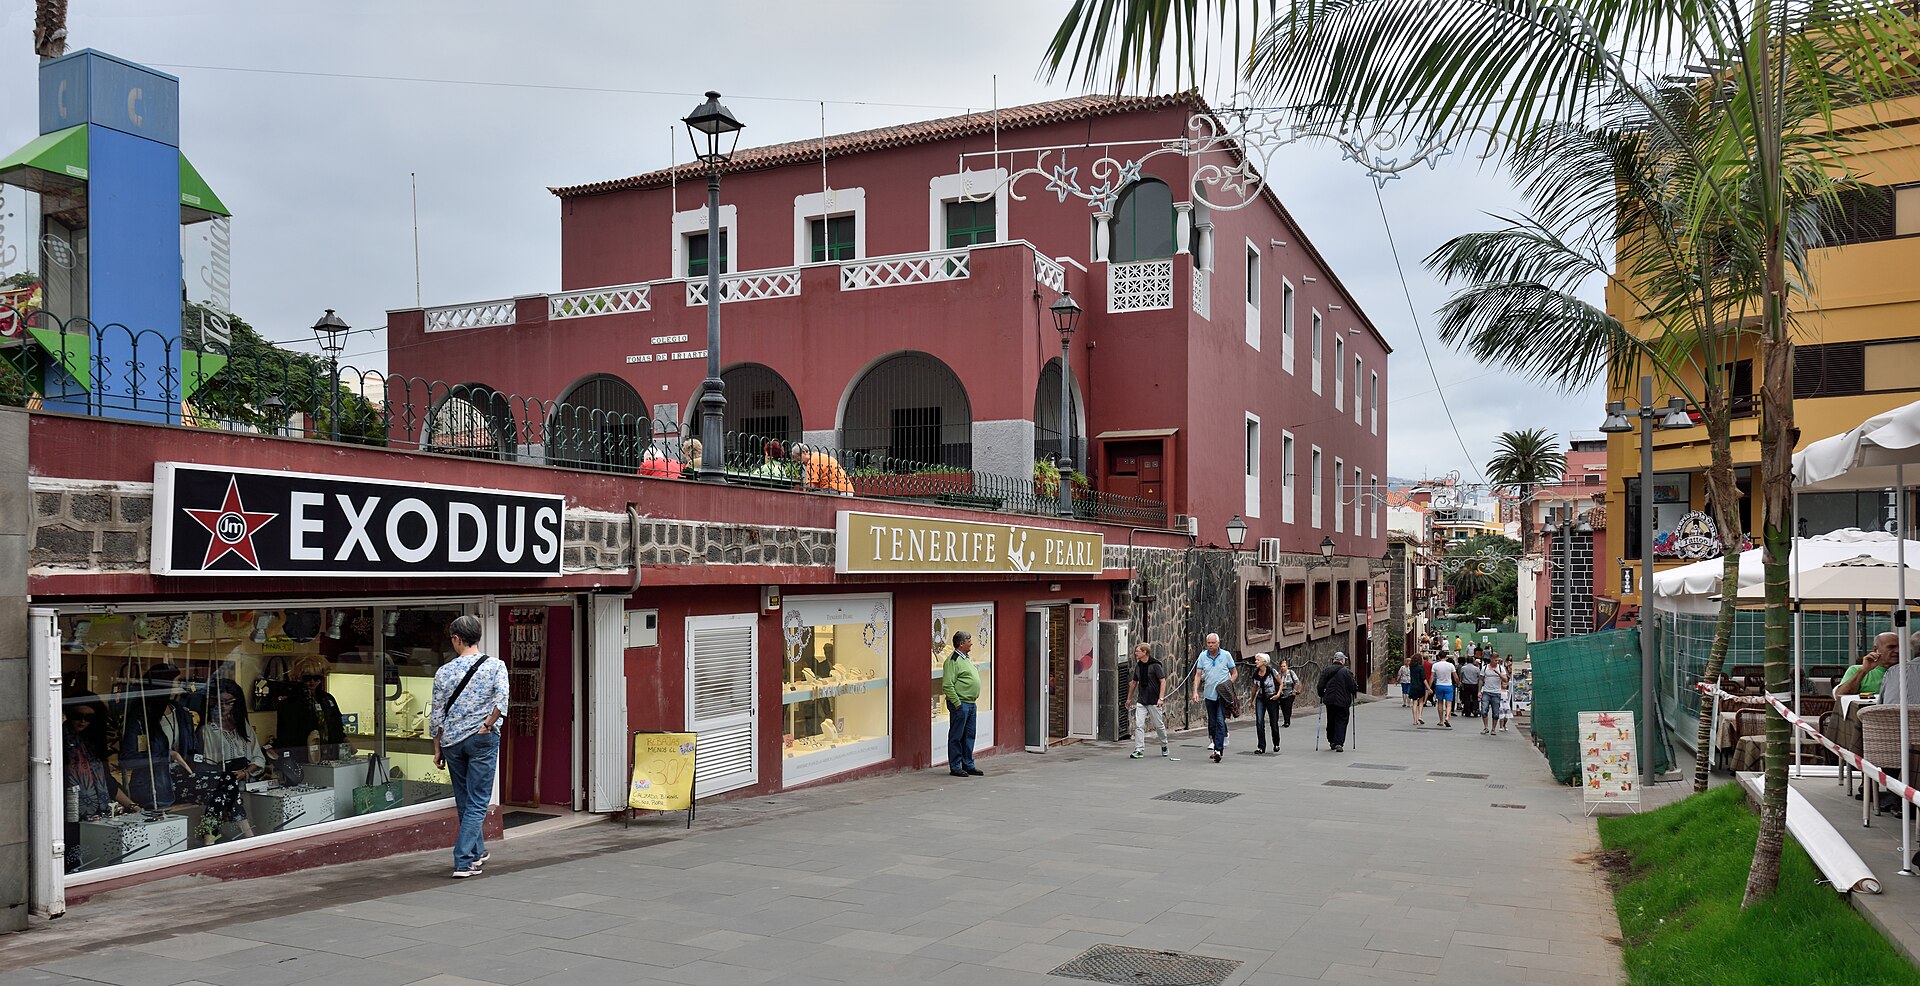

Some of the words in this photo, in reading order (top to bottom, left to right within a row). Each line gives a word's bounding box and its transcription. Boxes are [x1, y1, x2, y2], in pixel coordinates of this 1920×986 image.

[651, 334, 688, 344] COLEGIO
[627, 355, 652, 363] TOMAS
[656, 353, 667, 361] DE
[290, 491, 558, 564] EXODUS
[870, 525, 996, 562] TENERIFE
[1045, 538, 1094, 566] PEARL
[646, 737, 680, 747] REBAJAS
